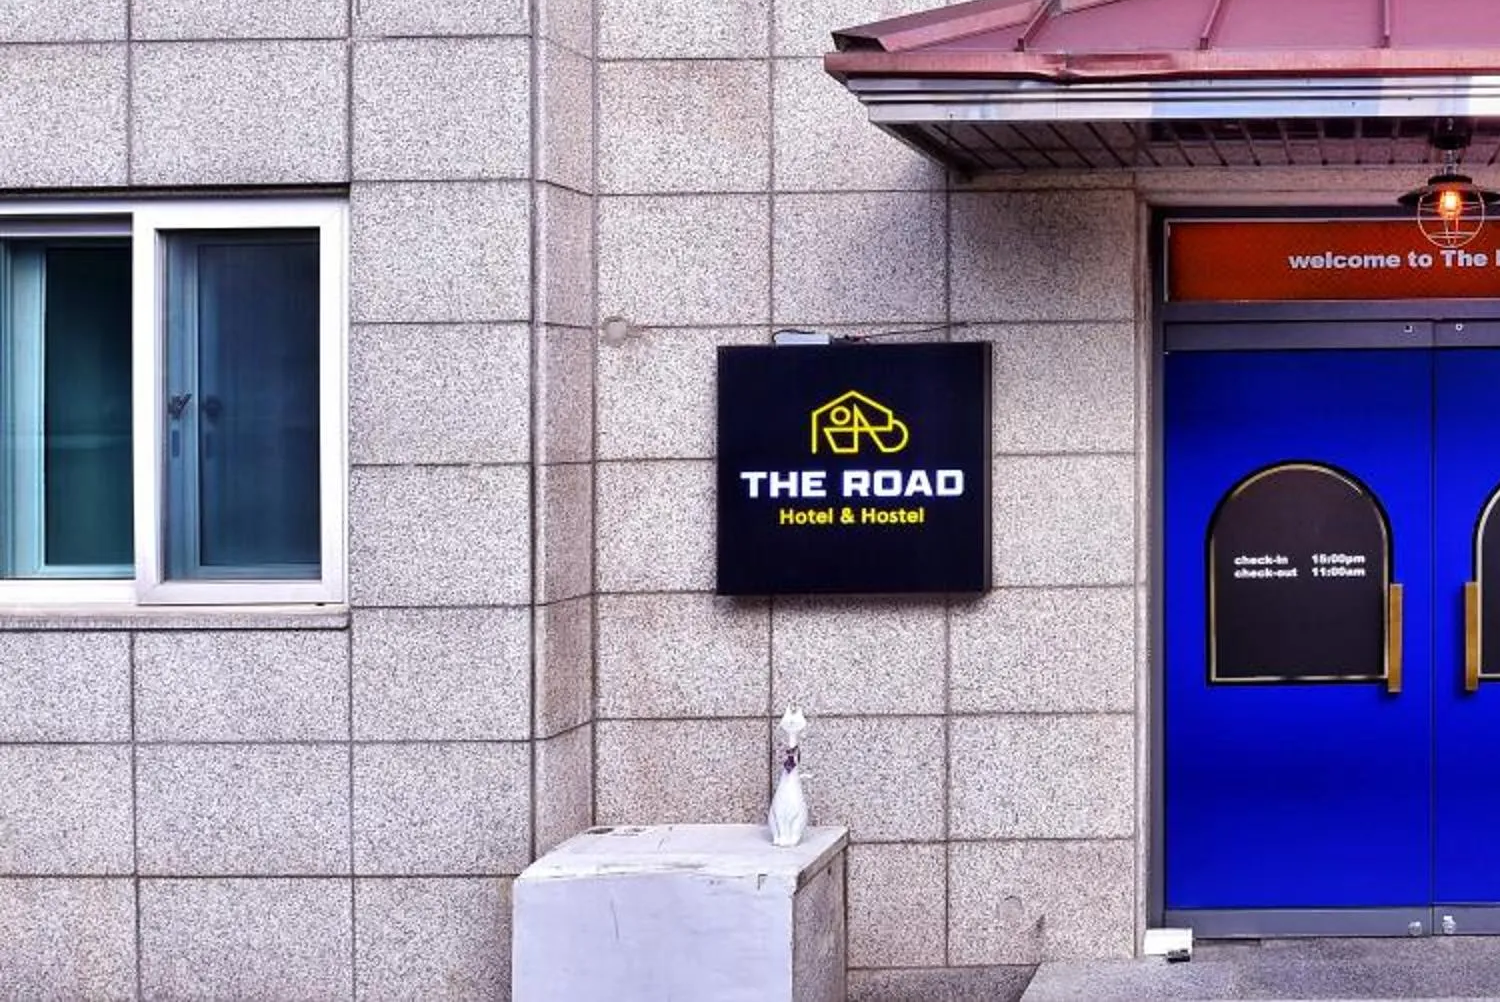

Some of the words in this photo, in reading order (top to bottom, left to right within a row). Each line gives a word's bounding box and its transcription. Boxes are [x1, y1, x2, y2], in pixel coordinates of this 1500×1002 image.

[1289, 251, 1400, 268] welcome
[1408, 251, 1432, 267] to
[1440, 250, 1488, 267] The
[740, 471, 827, 498] THE
[843, 469, 964, 497] ROAD
[779, 508, 833, 525] Hotel
[840, 508, 855, 524] &
[861, 507, 925, 524] Hostel
[1234, 554, 1289, 565] check-in
[1234, 568, 1298, 578] check-out
[1312, 567, 1366, 577] 11:00am
